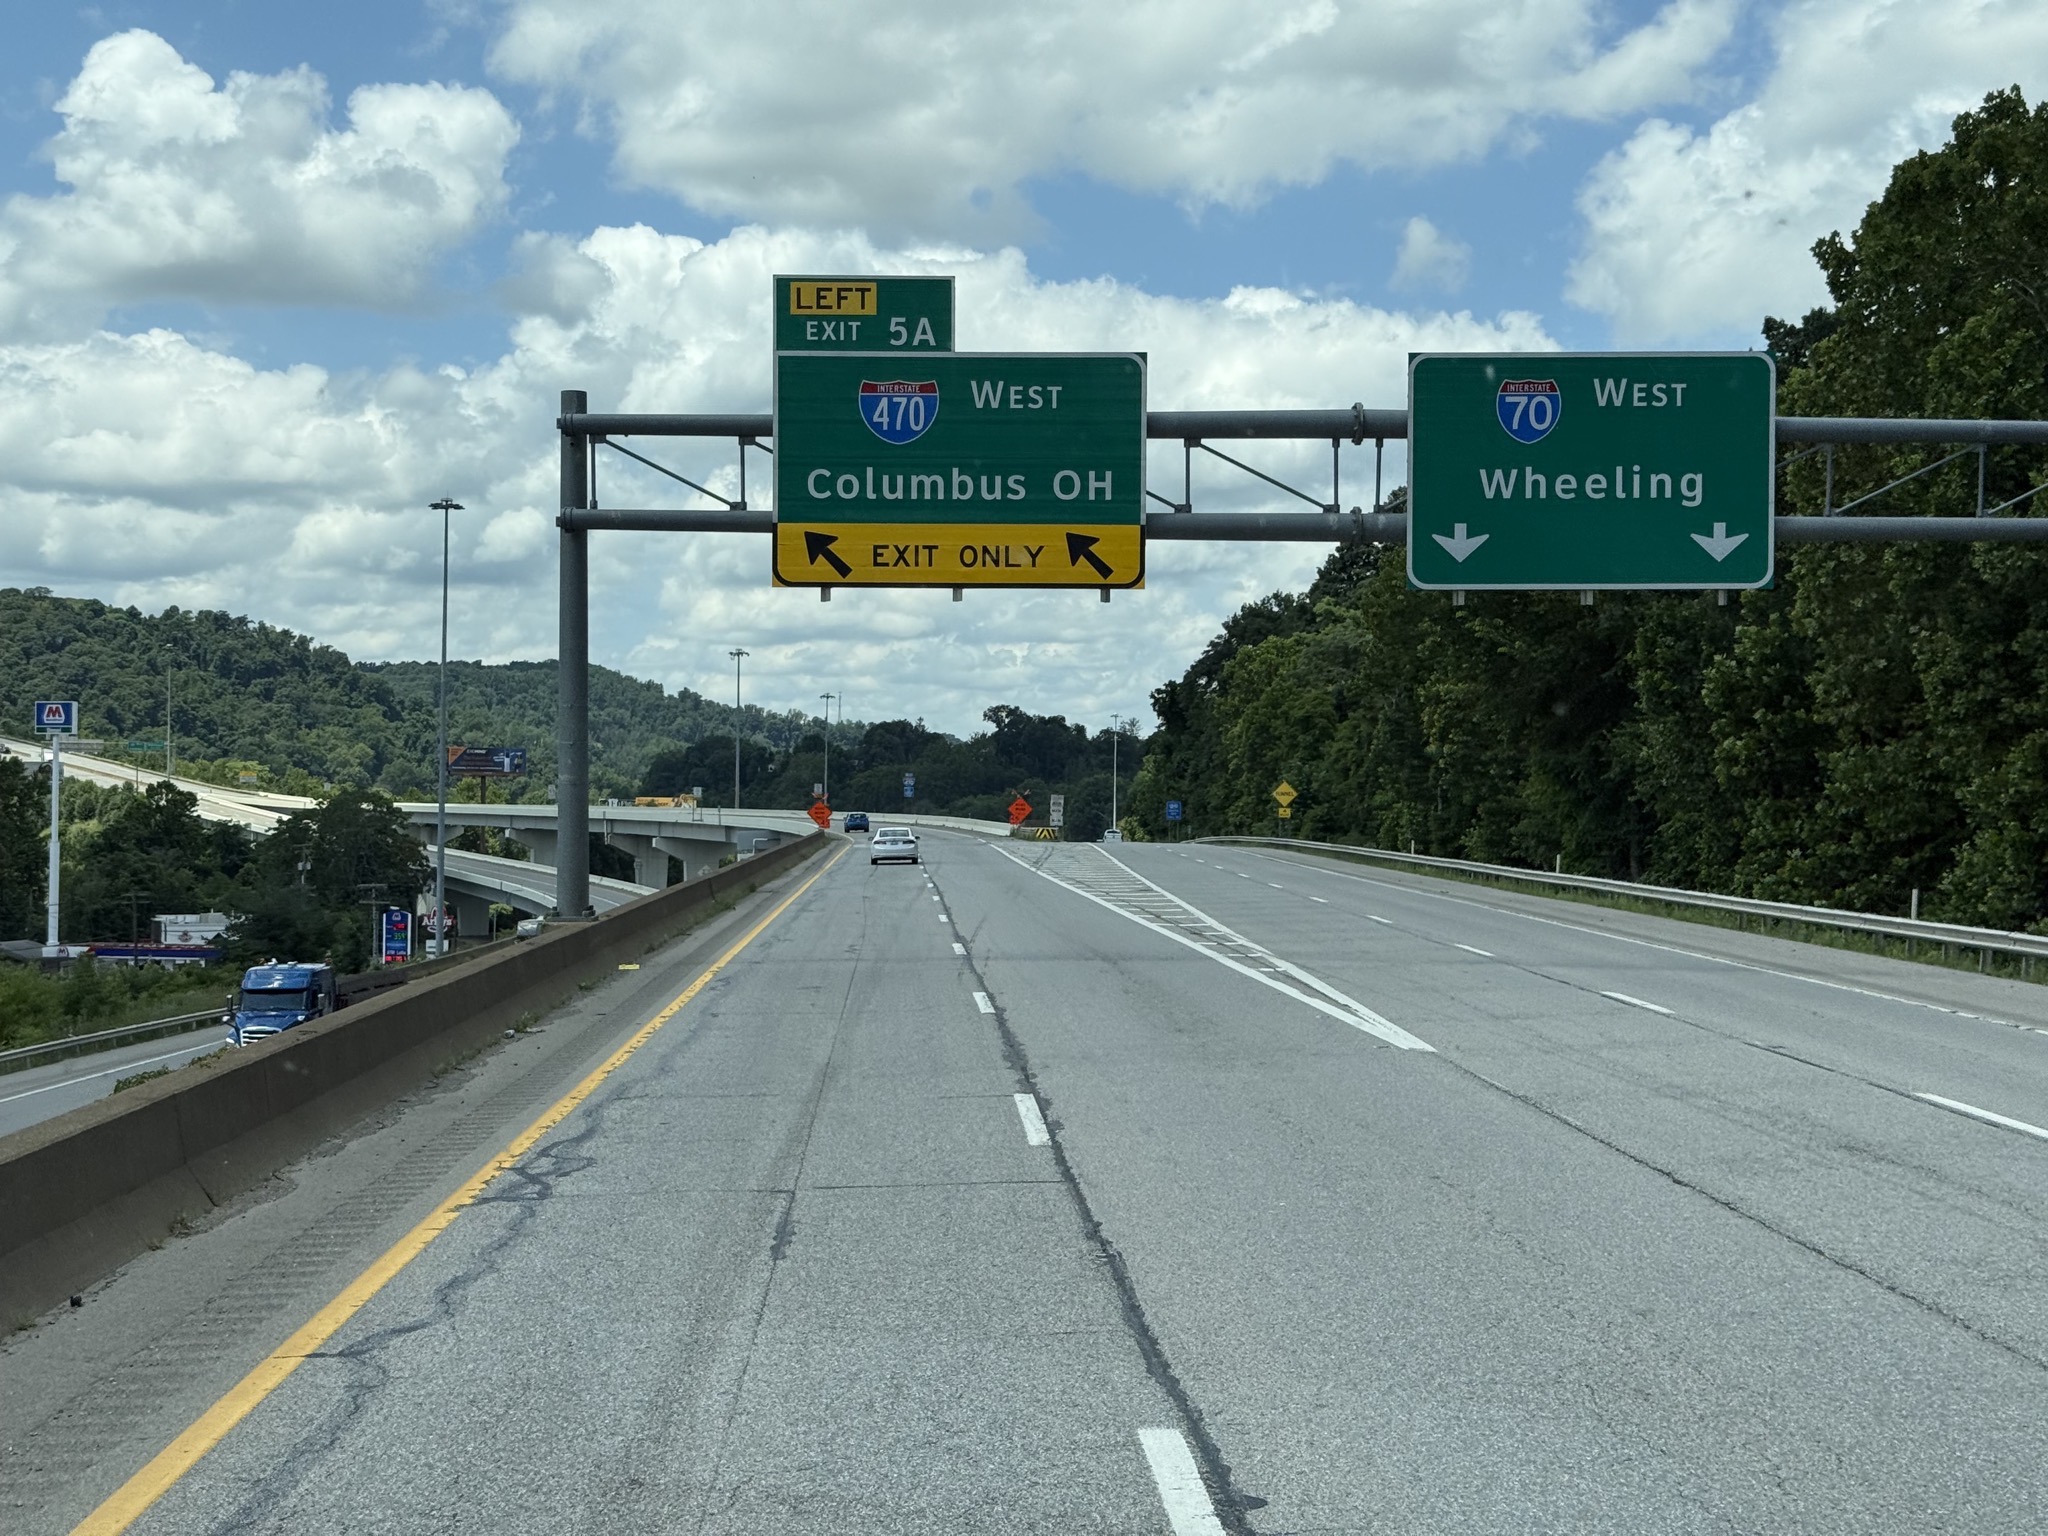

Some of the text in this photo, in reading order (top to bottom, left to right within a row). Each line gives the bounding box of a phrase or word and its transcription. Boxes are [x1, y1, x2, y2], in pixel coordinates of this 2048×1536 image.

[796, 287, 872, 310] LEFT
[806, 317, 937, 347] EXIT 5A
[877, 384, 921, 394] INTERSTATE
[971, 380, 1063, 409] WEST
[1506, 383, 1551, 393] INTERSTATE
[1594, 377, 1687, 408] WEST
[872, 397, 925, 431] 470
[1504, 395, 1552, 431] 70
[807, 466, 1113, 501] Columbus OH
[1479, 465, 1703, 508] Wheeling
[872, 544, 1045, 568] EXIT ONLY
[46, 706, 63, 718] M
